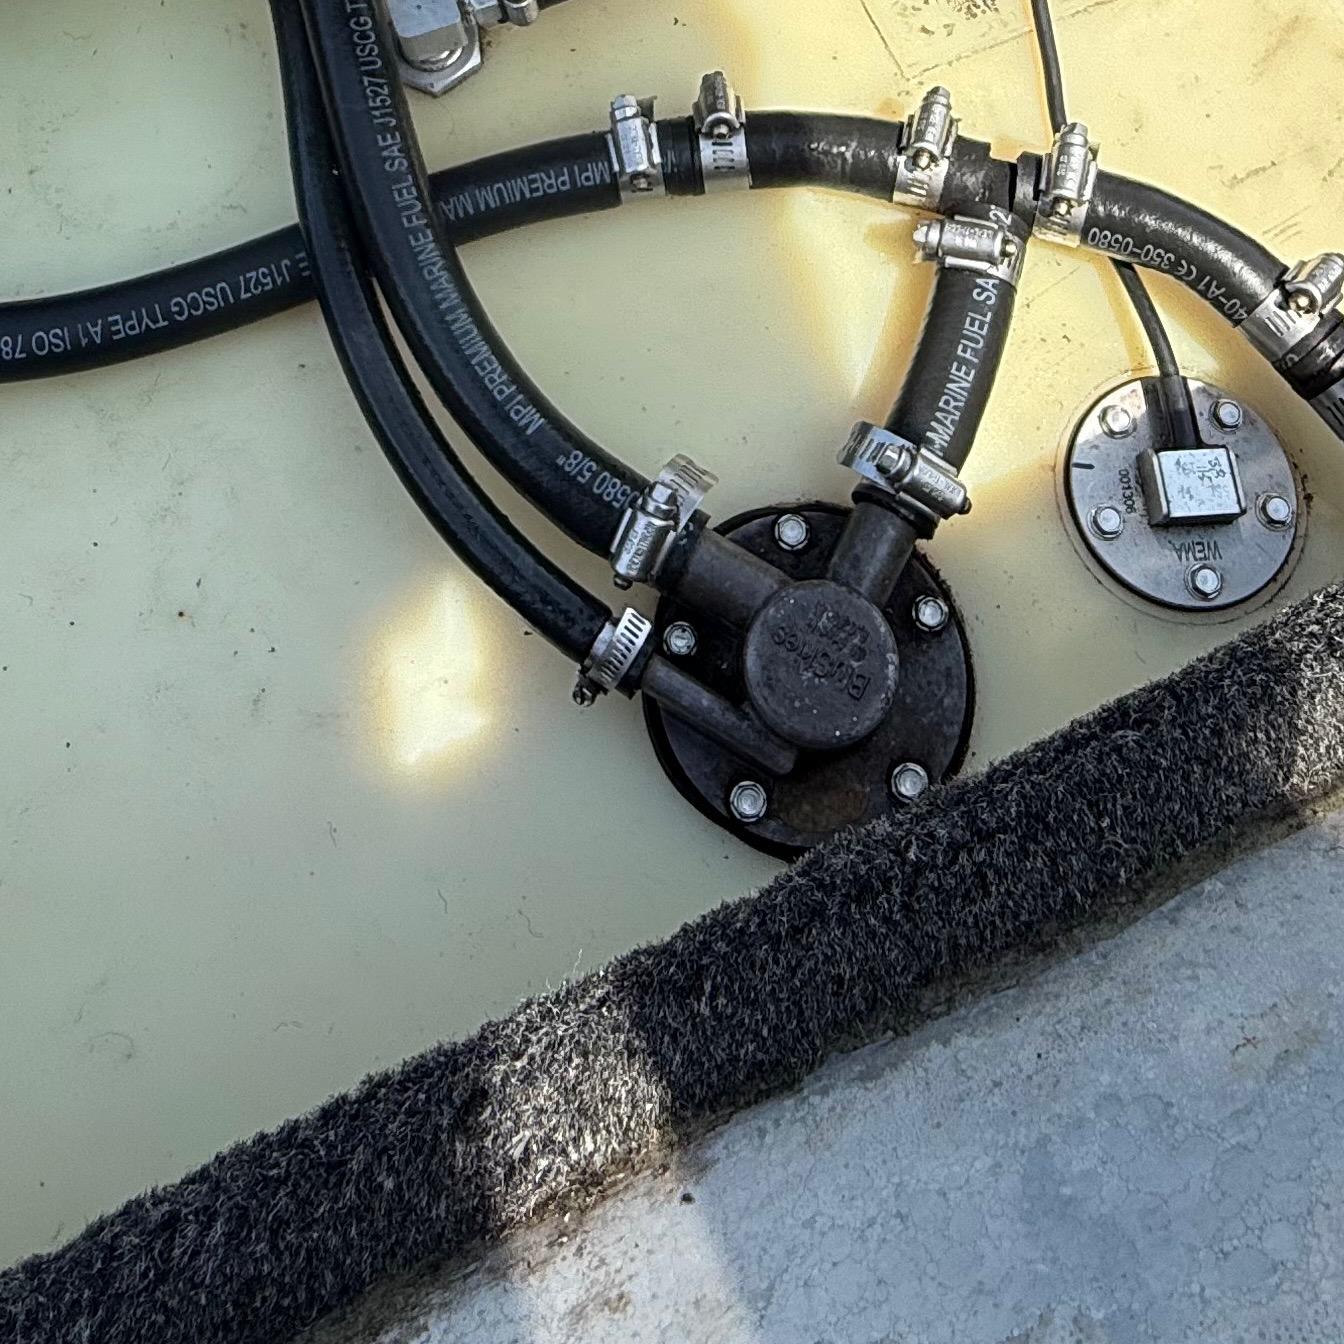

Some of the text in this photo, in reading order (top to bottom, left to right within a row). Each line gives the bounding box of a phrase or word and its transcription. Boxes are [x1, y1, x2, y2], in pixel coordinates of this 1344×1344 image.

[350, 14, 383, 71] USCG
[363, 75, 398, 128] J1527
[377, 130, 409, 172] SAE
[474, 165, 570, 211] PREMIUM
[572, 159, 610, 187] MPI
[391, 173, 428, 228] FUEL
[1086, 226, 1174, 269] 350-0580
[235, 258, 293, 298] J1527
[410, 228, 466, 310] MARINE
[168, 280, 234, 321] USCG
[971, 276, 999, 305] SA
[1197, 273, 1249, 322] 40-A1
[29, 326, 72, 355] ISO
[76, 318, 106, 346] A1
[106, 302, 168, 340] TYPE
[956, 305, 991, 362] FUEL
[445, 307, 519, 402] PREMIUM
[506, 394, 546, 436] MPI
[924, 360, 976, 446] MARINE
[554, 447, 598, 484] 5/8"
[1172, 540, 1223, 562] WEMA
